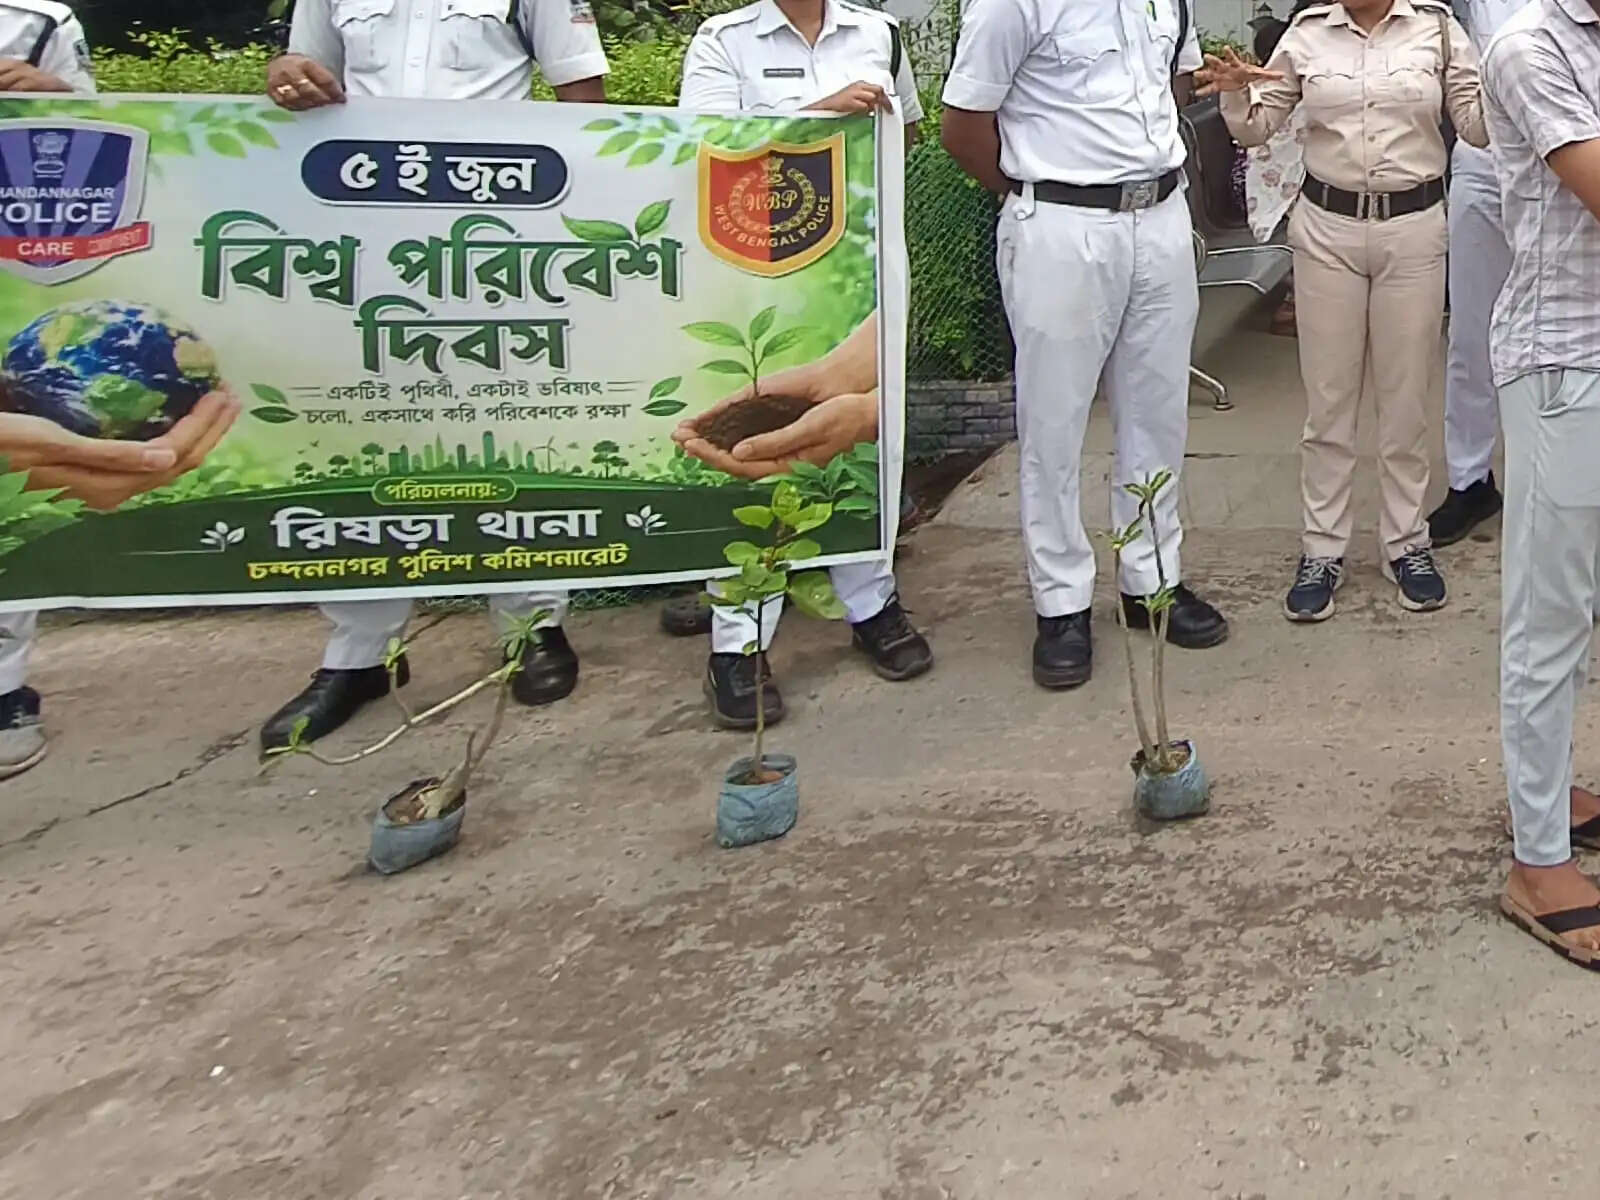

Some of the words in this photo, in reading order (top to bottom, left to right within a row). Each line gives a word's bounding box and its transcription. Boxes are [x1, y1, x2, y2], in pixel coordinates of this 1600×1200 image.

[340, 153, 378, 189] ৫
[395, 144, 431, 196] ই
[445, 156, 536, 201] জুন
[0, 202, 113, 224] OLICE
[714, 204, 738, 236] WEST
[737, 234, 799, 248] BENGAL
[800, 195, 831, 238] POLICE
[18, 242, 74, 256] CARE
[193, 210, 361, 306] বিশ্ব
[387, 213, 683, 304] পরিবেশ
[353, 295, 570, 374] দিবস
[271, 506, 455, 549] রিষড়া
[476, 509, 603, 540] থানা
[249, 556, 389, 579] চন্দননগর
[399, 548, 473, 580] পুলিশ
[482, 544, 629, 569] কমিশনারেট
